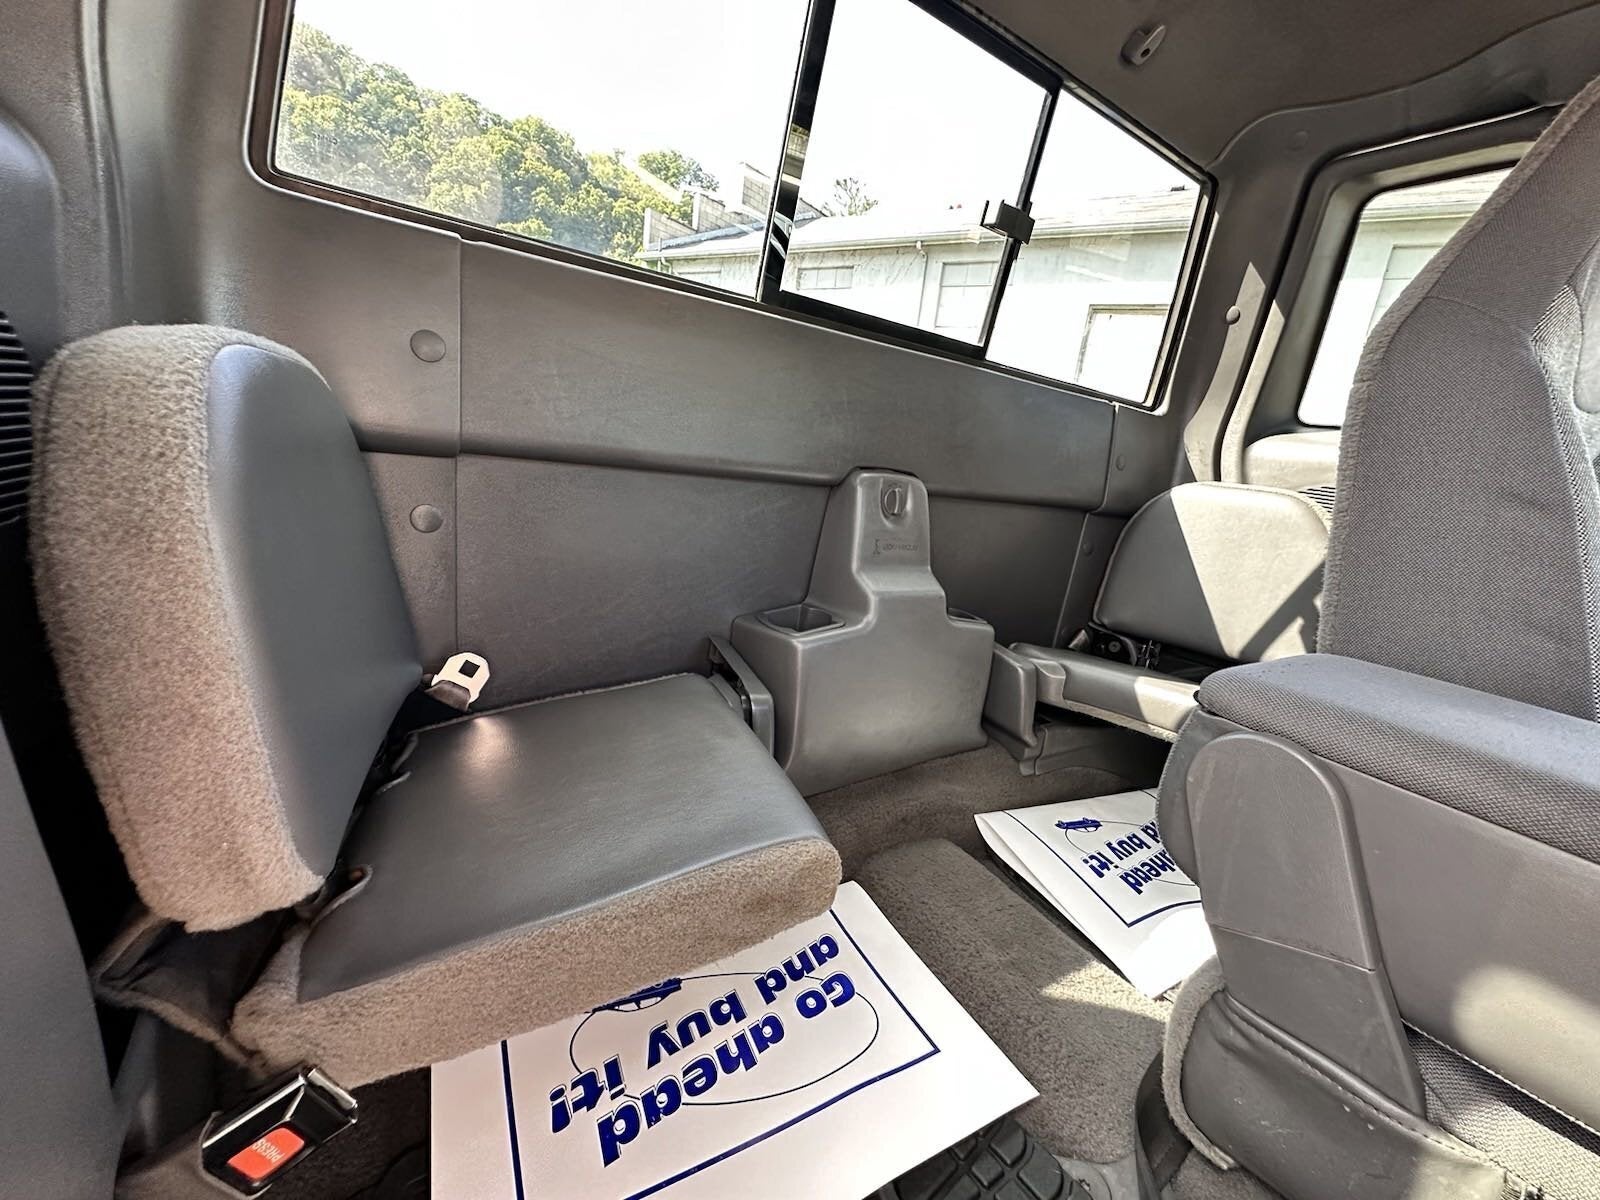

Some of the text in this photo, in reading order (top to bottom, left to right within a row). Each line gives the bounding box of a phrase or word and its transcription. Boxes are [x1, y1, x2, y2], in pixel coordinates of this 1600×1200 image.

[1104, 832, 1152, 861] buy
[1081, 851, 1119, 879] it!
[549, 933, 840, 1134] and buy it!
[597, 971, 856, 1167] Go ahead
[252, 1138, 284, 1163] PRESS
